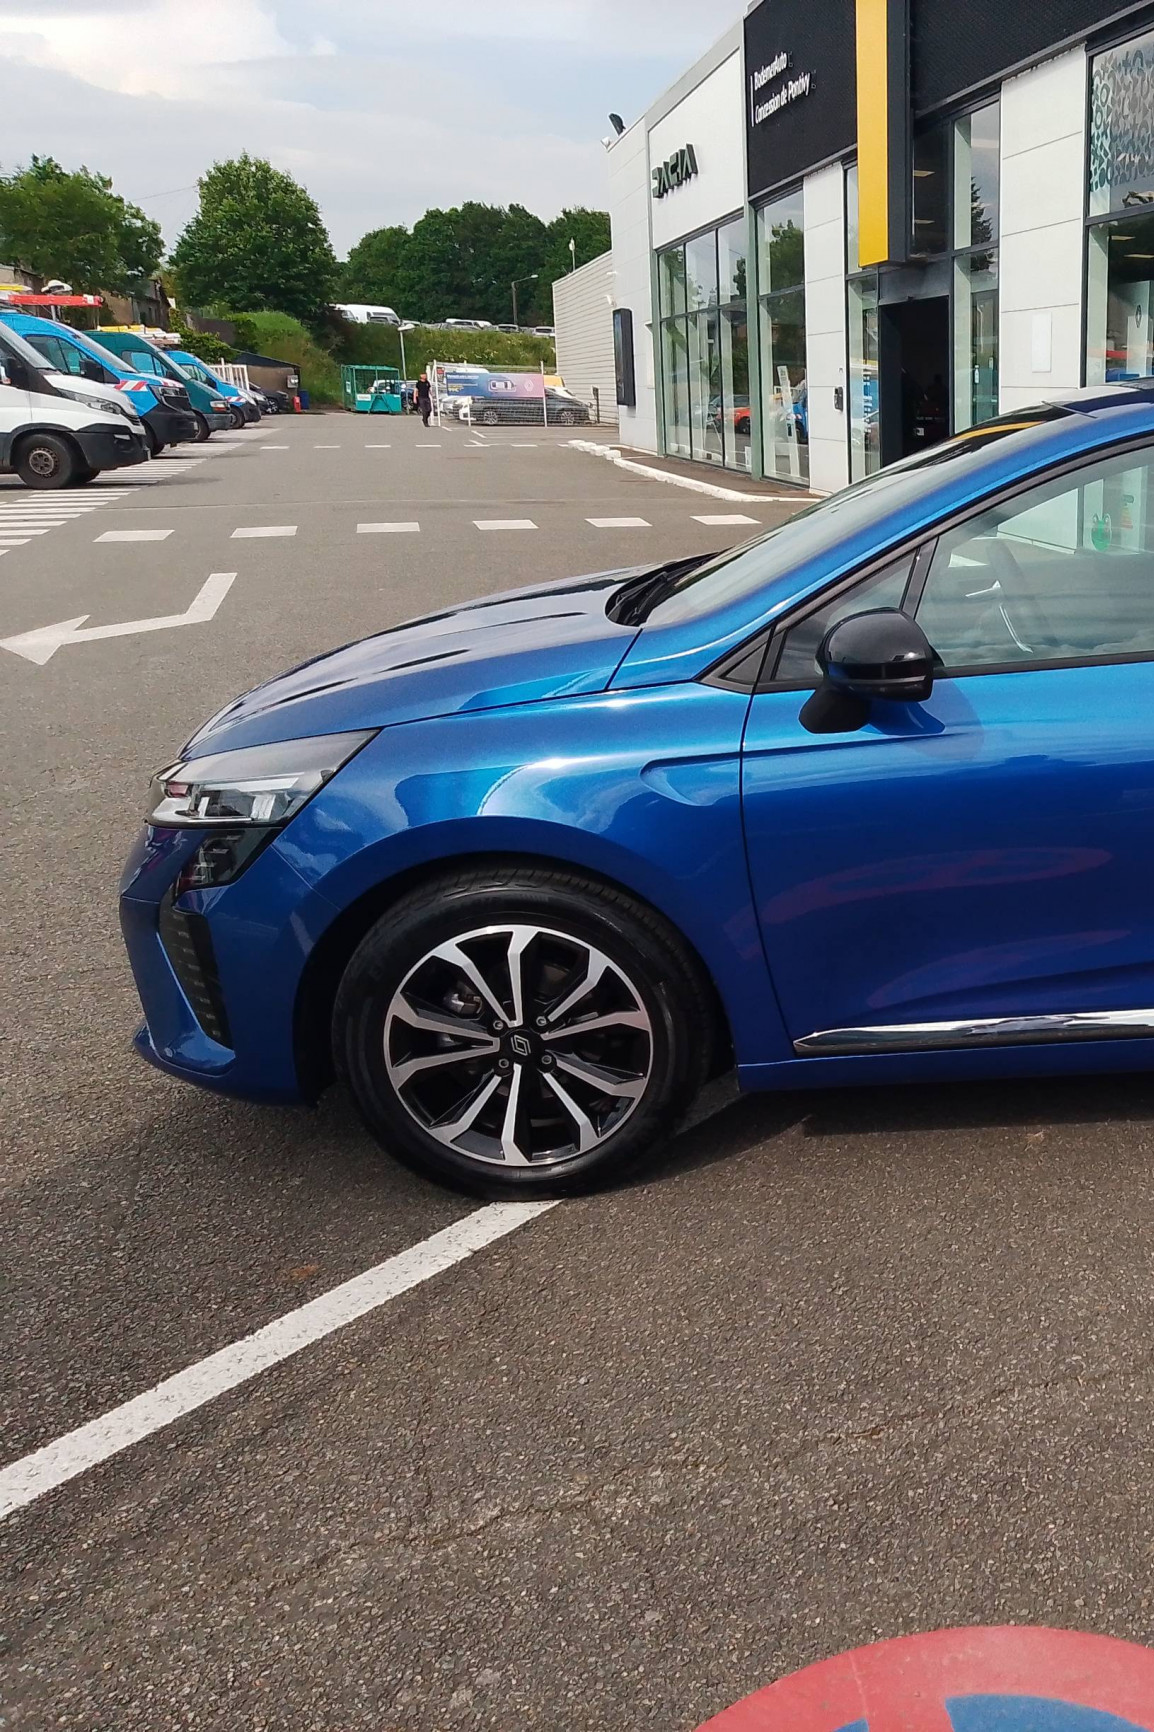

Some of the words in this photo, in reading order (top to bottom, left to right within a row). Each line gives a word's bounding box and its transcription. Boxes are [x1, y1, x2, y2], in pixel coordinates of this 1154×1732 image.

[755, 92, 780, 124] Concession
[781, 84, 787, 106] de
[788, 72, 811, 102] Pontivy
[651, 143, 699, 199] DACIA
